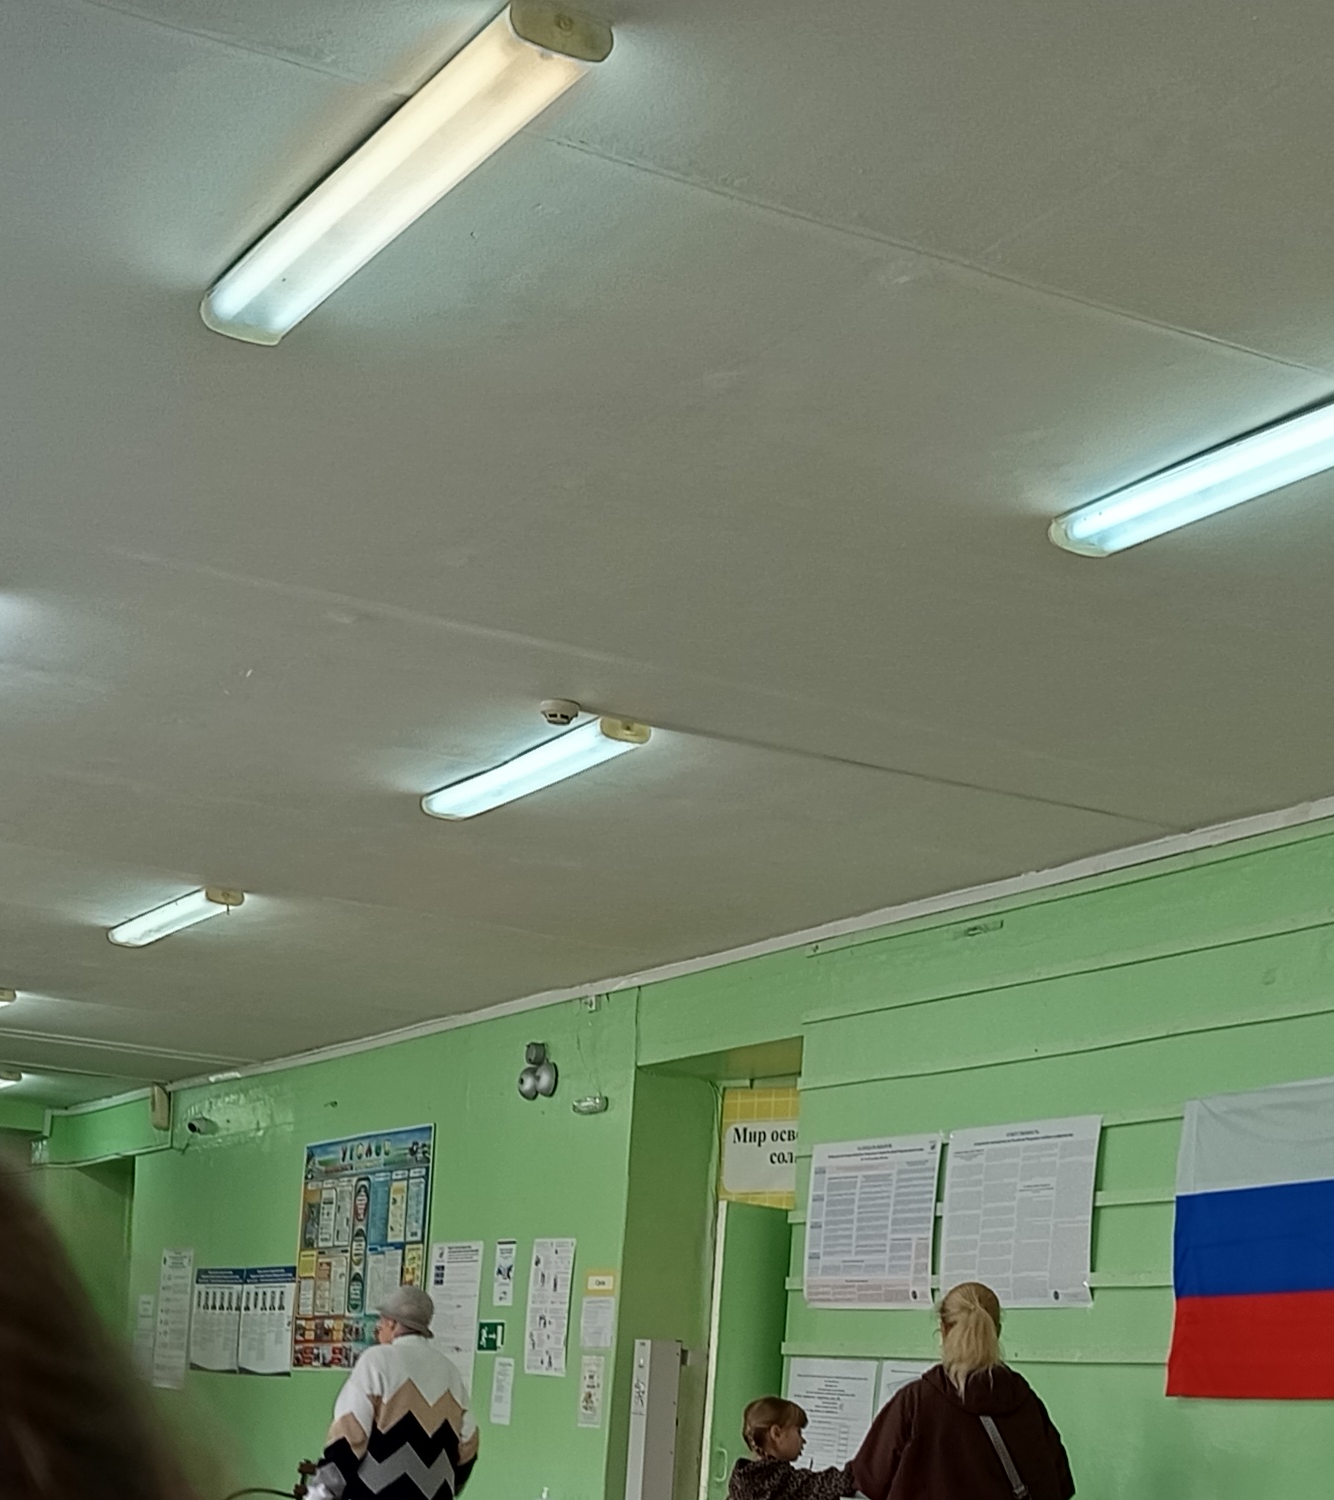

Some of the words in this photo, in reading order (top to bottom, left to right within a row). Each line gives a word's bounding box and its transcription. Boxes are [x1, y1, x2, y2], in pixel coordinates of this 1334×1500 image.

[733, 1127, 766, 1147] Мир
[771, 1129, 798, 1142] осв
[770, 1152, 796, 1164] сол
